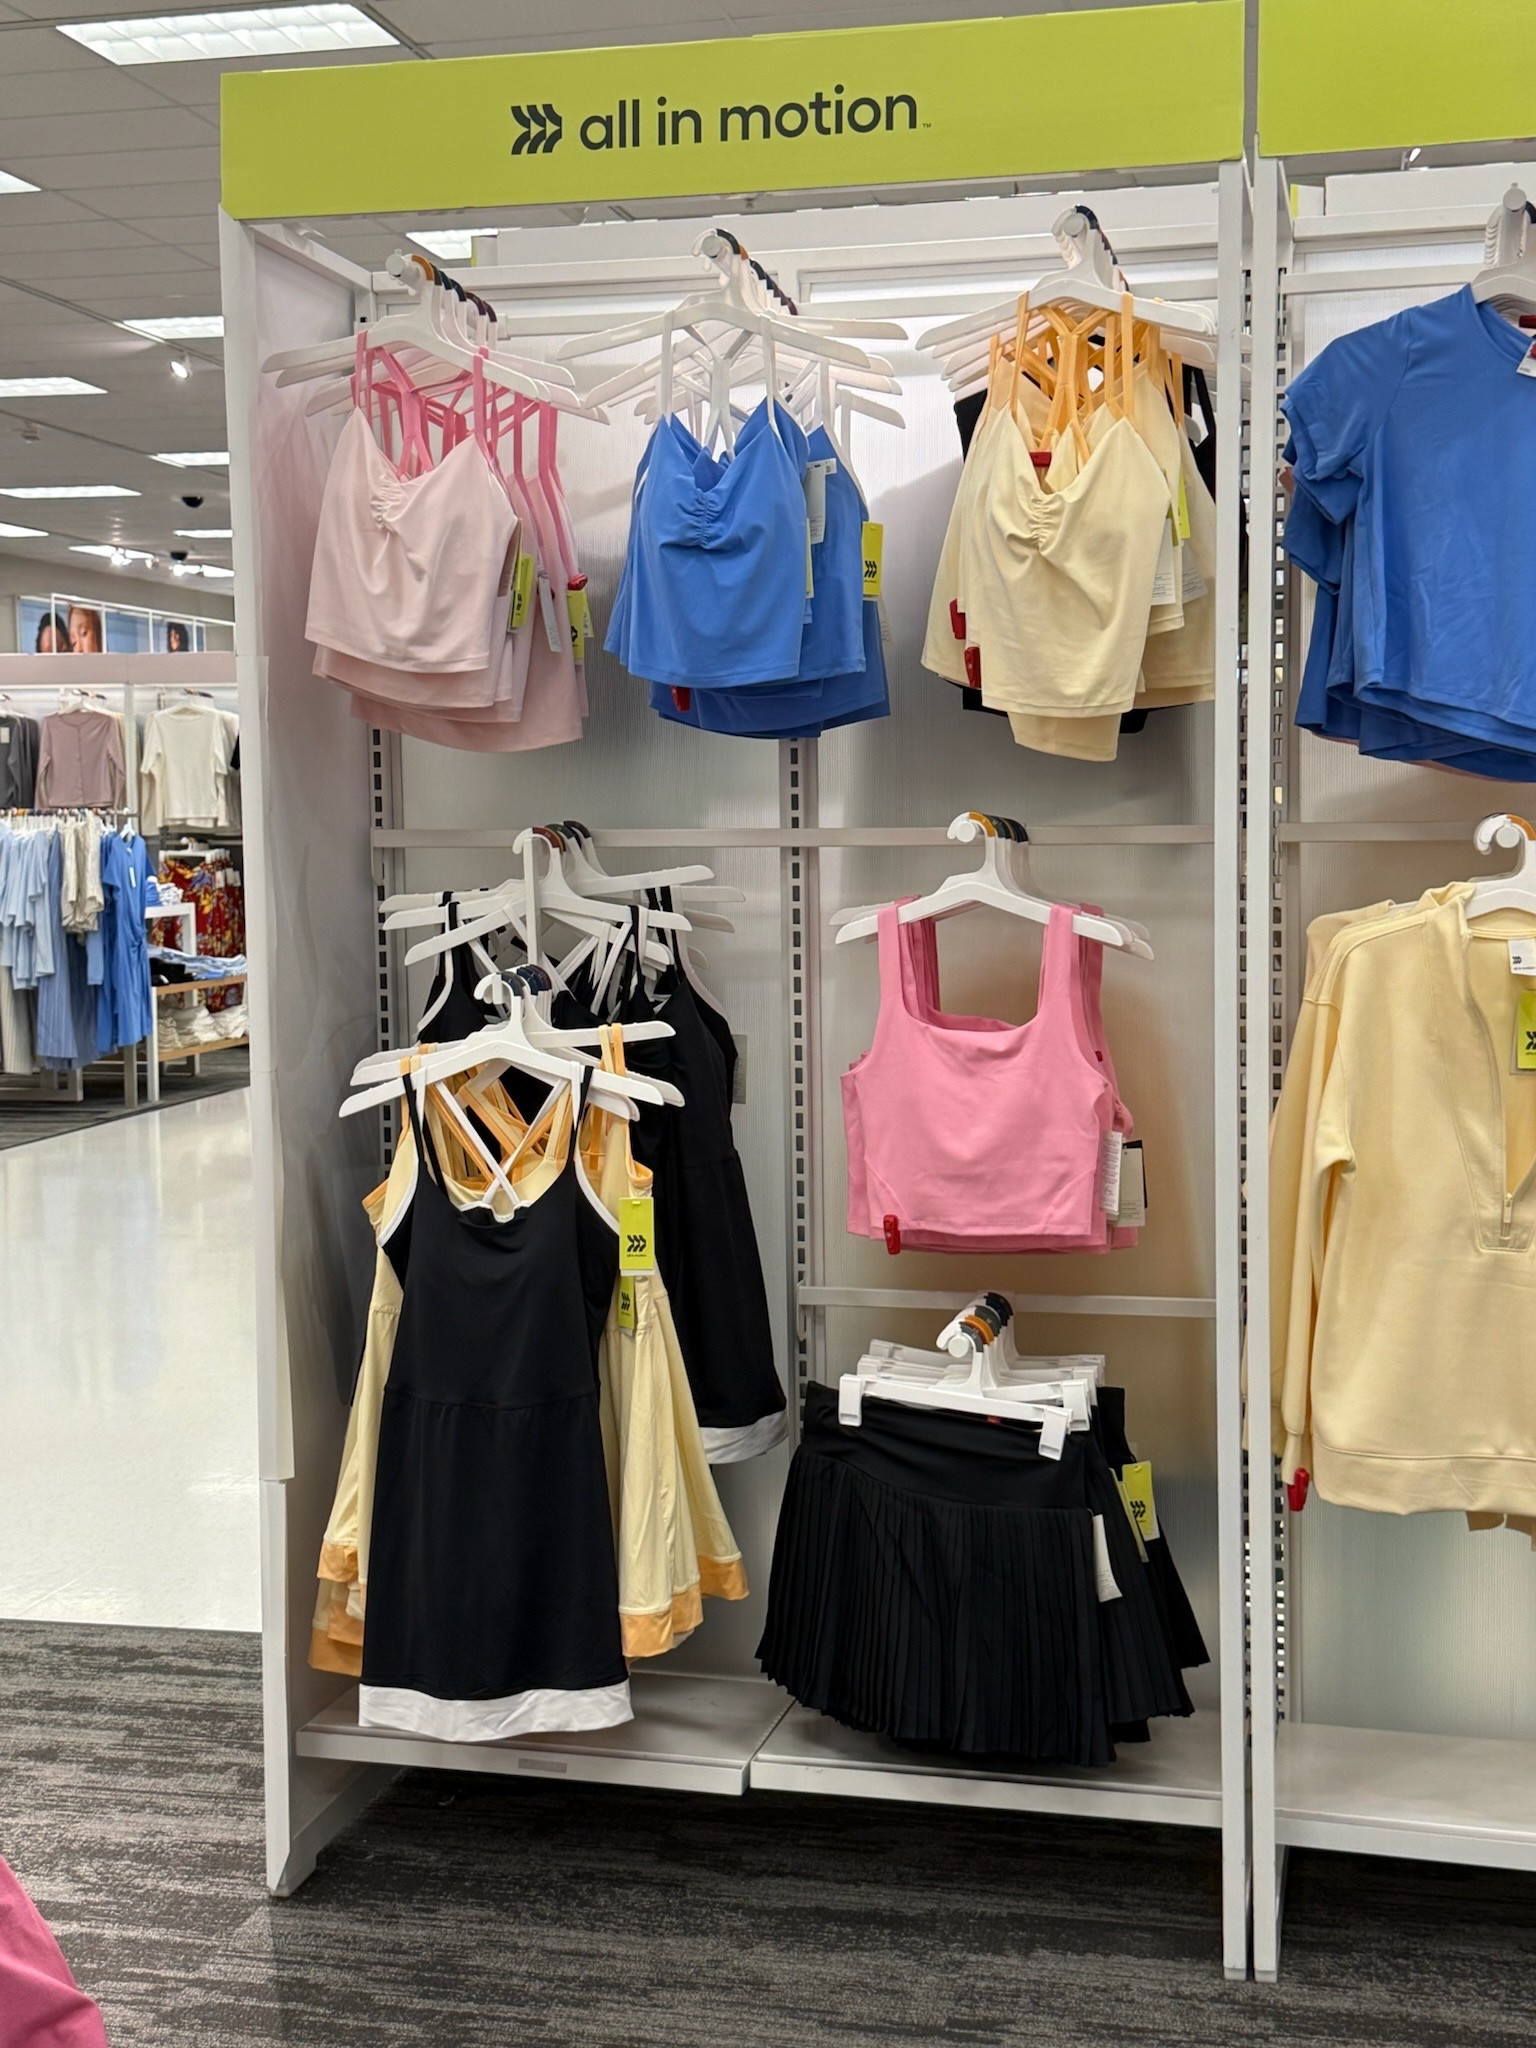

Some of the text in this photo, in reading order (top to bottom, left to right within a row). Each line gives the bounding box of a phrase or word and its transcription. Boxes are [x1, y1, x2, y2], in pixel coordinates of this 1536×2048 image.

[580, 99, 640, 151] all
[658, 96, 702, 146] in
[720, 84, 917, 142] motion
